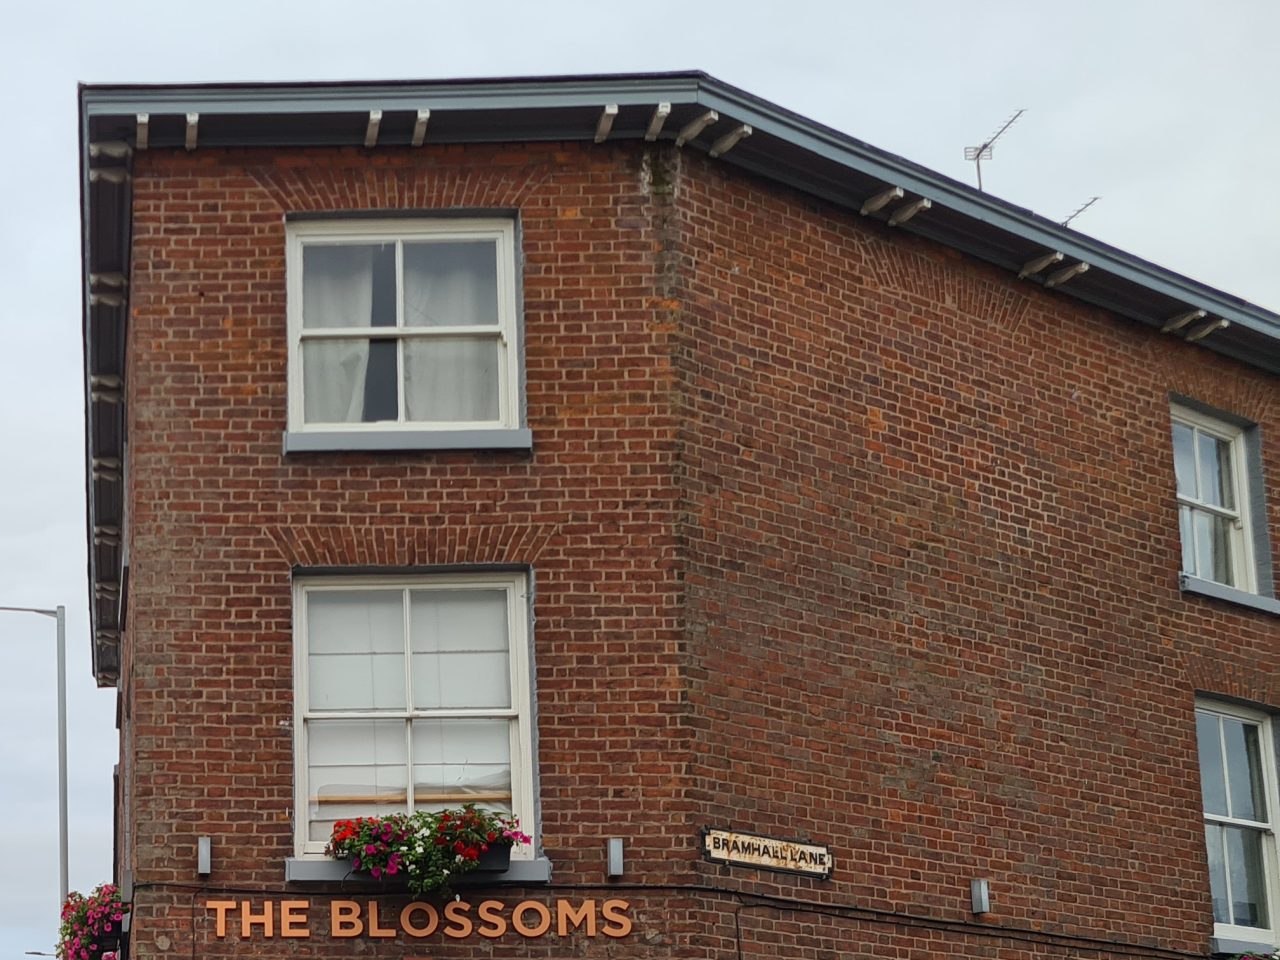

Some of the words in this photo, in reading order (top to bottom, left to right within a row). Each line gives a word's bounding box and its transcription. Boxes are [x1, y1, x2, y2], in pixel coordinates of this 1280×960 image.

[713, 837, 787, 860] BRAMHALL
[790, 849, 826, 865] LANE
[206, 900, 310, 938] THE
[331, 899, 632, 938] BLOSSOMS
